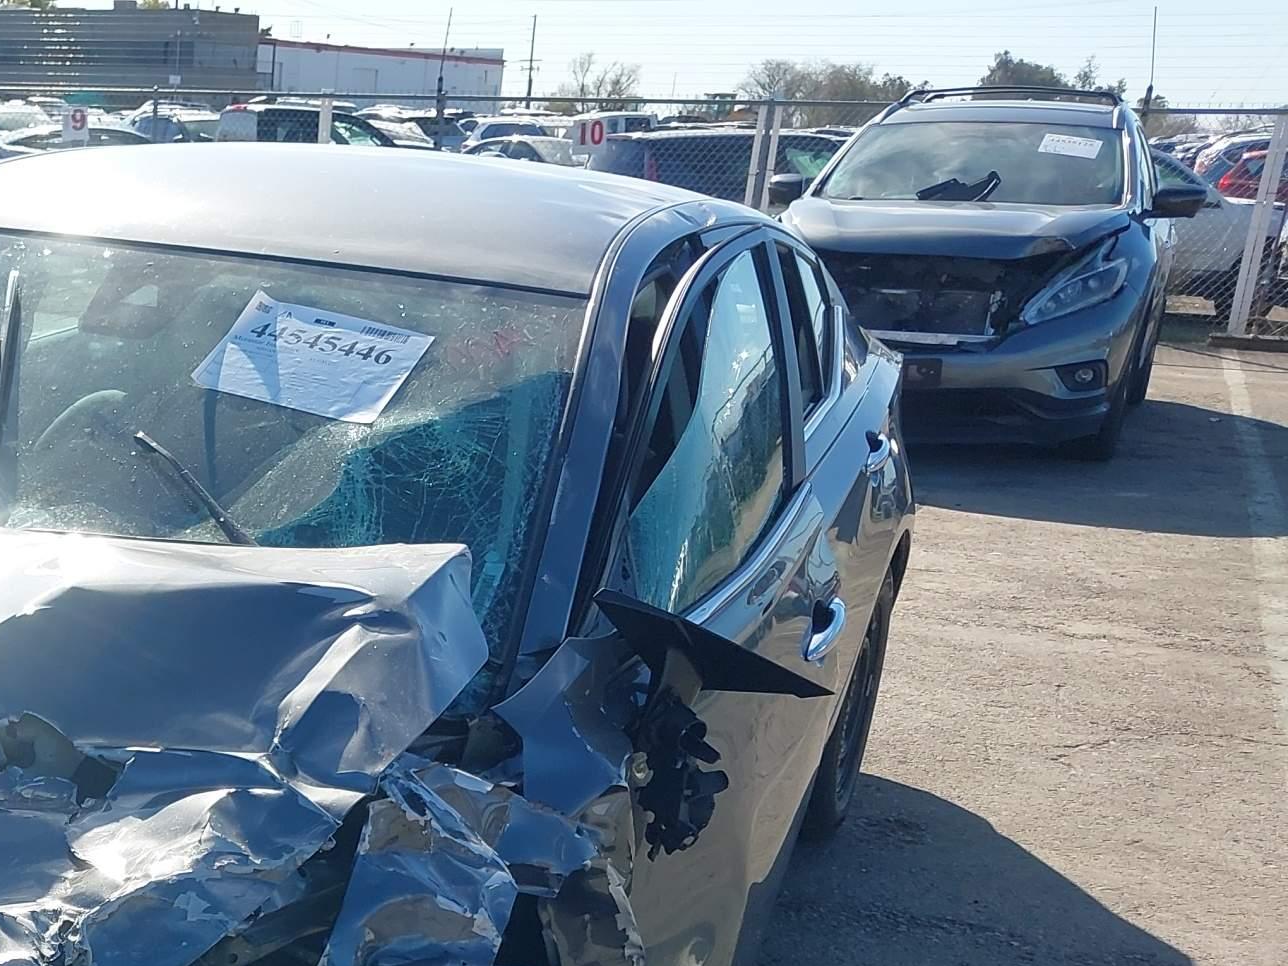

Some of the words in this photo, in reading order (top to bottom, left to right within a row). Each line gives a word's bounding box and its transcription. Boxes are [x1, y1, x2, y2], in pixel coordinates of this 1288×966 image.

[71, 109, 85, 131] 9
[579, 120, 604, 145] 10
[250, 322, 397, 365] 44545446
